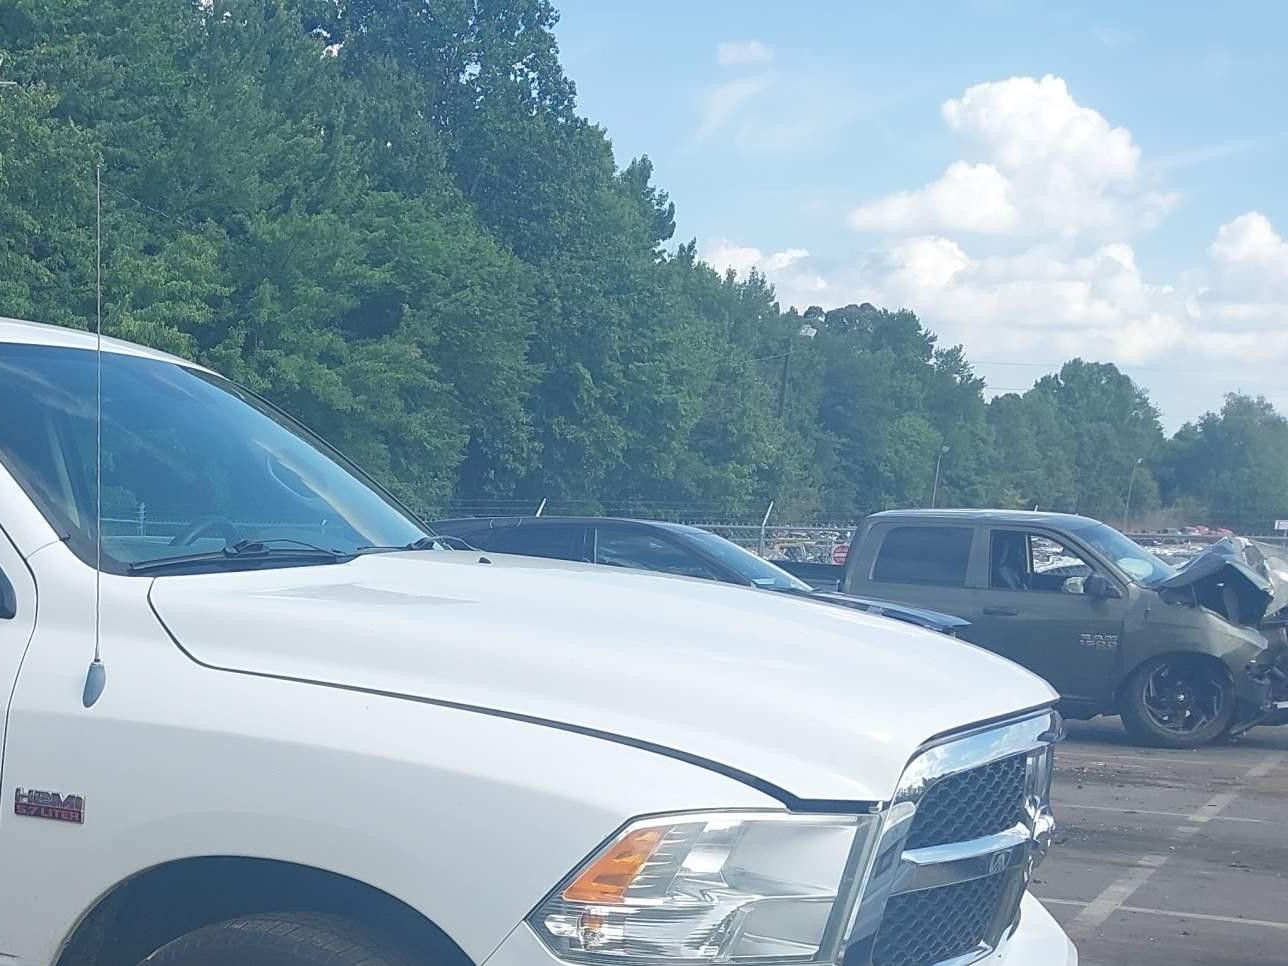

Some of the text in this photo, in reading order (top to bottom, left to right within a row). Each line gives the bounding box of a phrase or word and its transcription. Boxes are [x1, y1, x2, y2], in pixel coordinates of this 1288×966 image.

[15, 787, 85, 811] HEMI
[16, 803, 80, 821] 5.7 LITER
